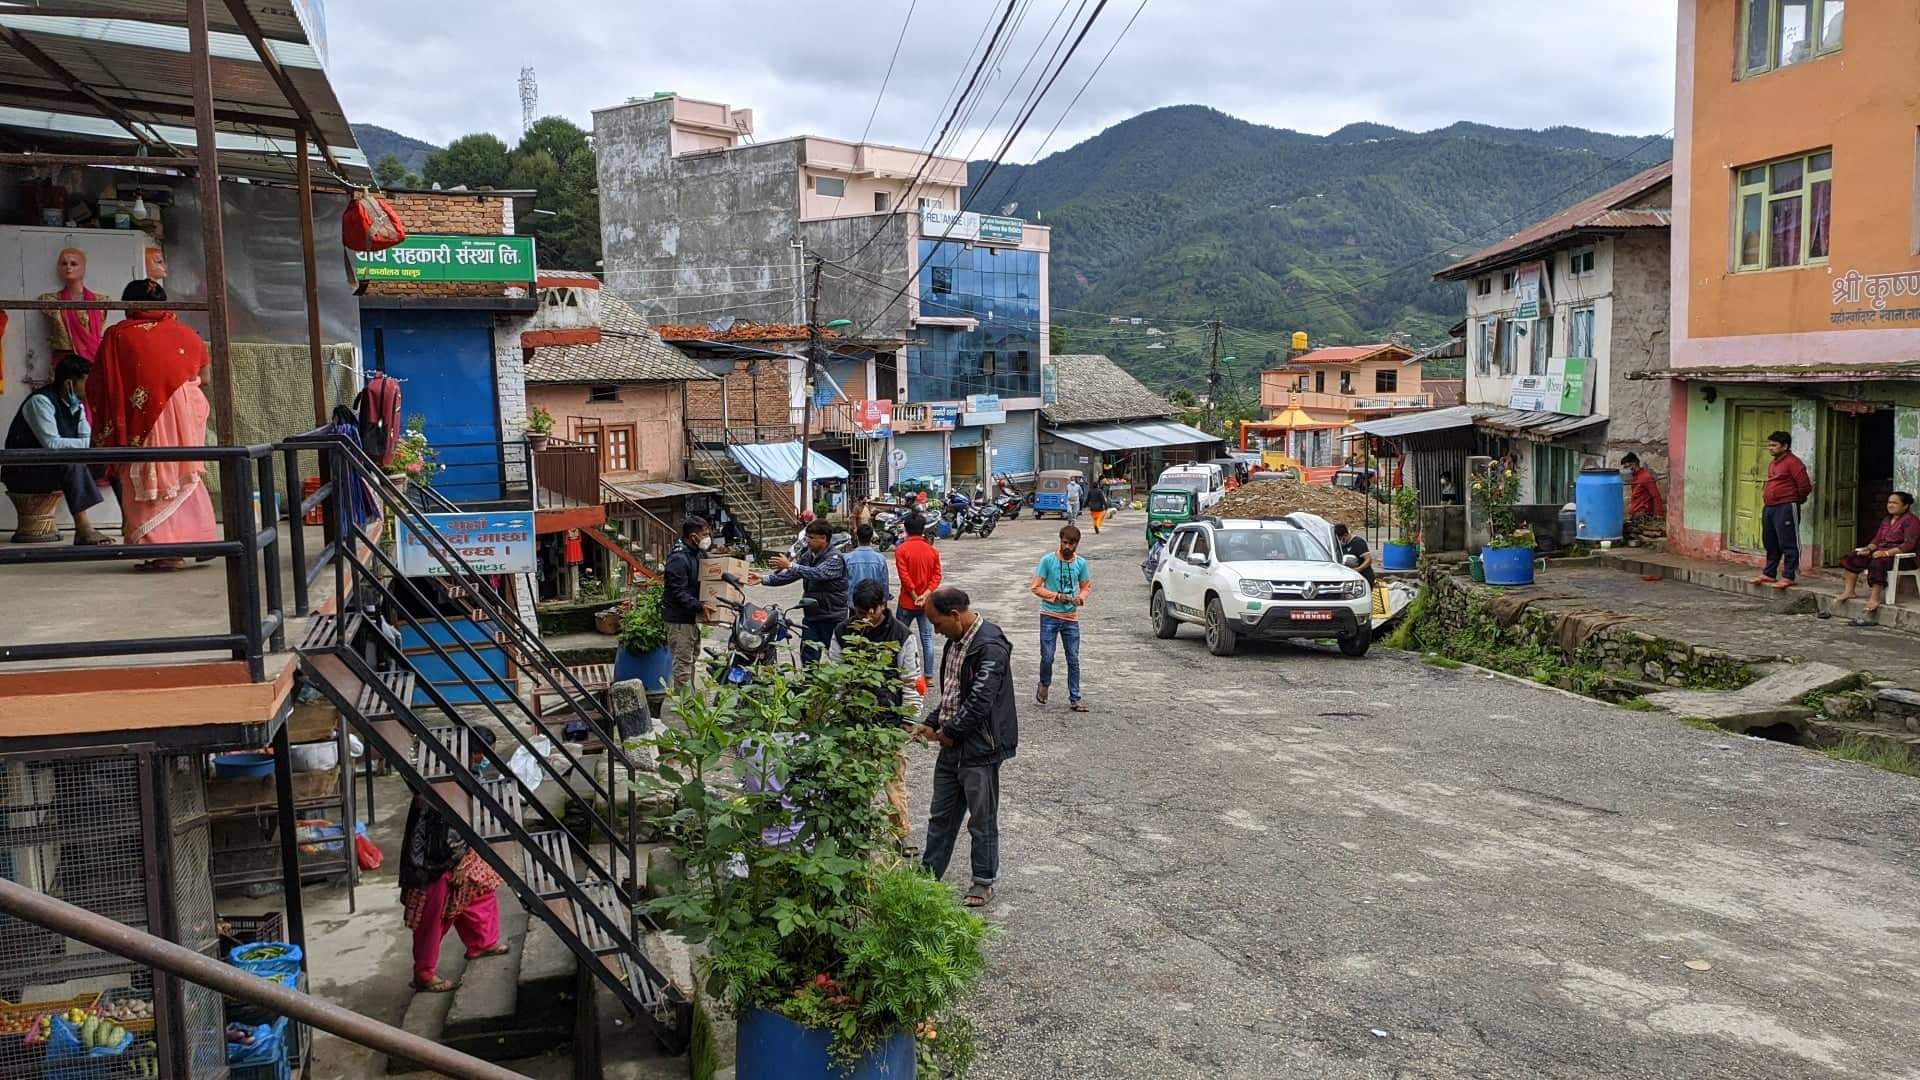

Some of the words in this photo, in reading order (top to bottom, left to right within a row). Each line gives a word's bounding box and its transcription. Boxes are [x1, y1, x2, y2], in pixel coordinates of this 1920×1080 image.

[392, 244, 451, 265] सहकारी
[455, 244, 495, 265] संस्था
[498, 245, 521, 265] लि.
[1832, 269, 1863, 304] श्री
